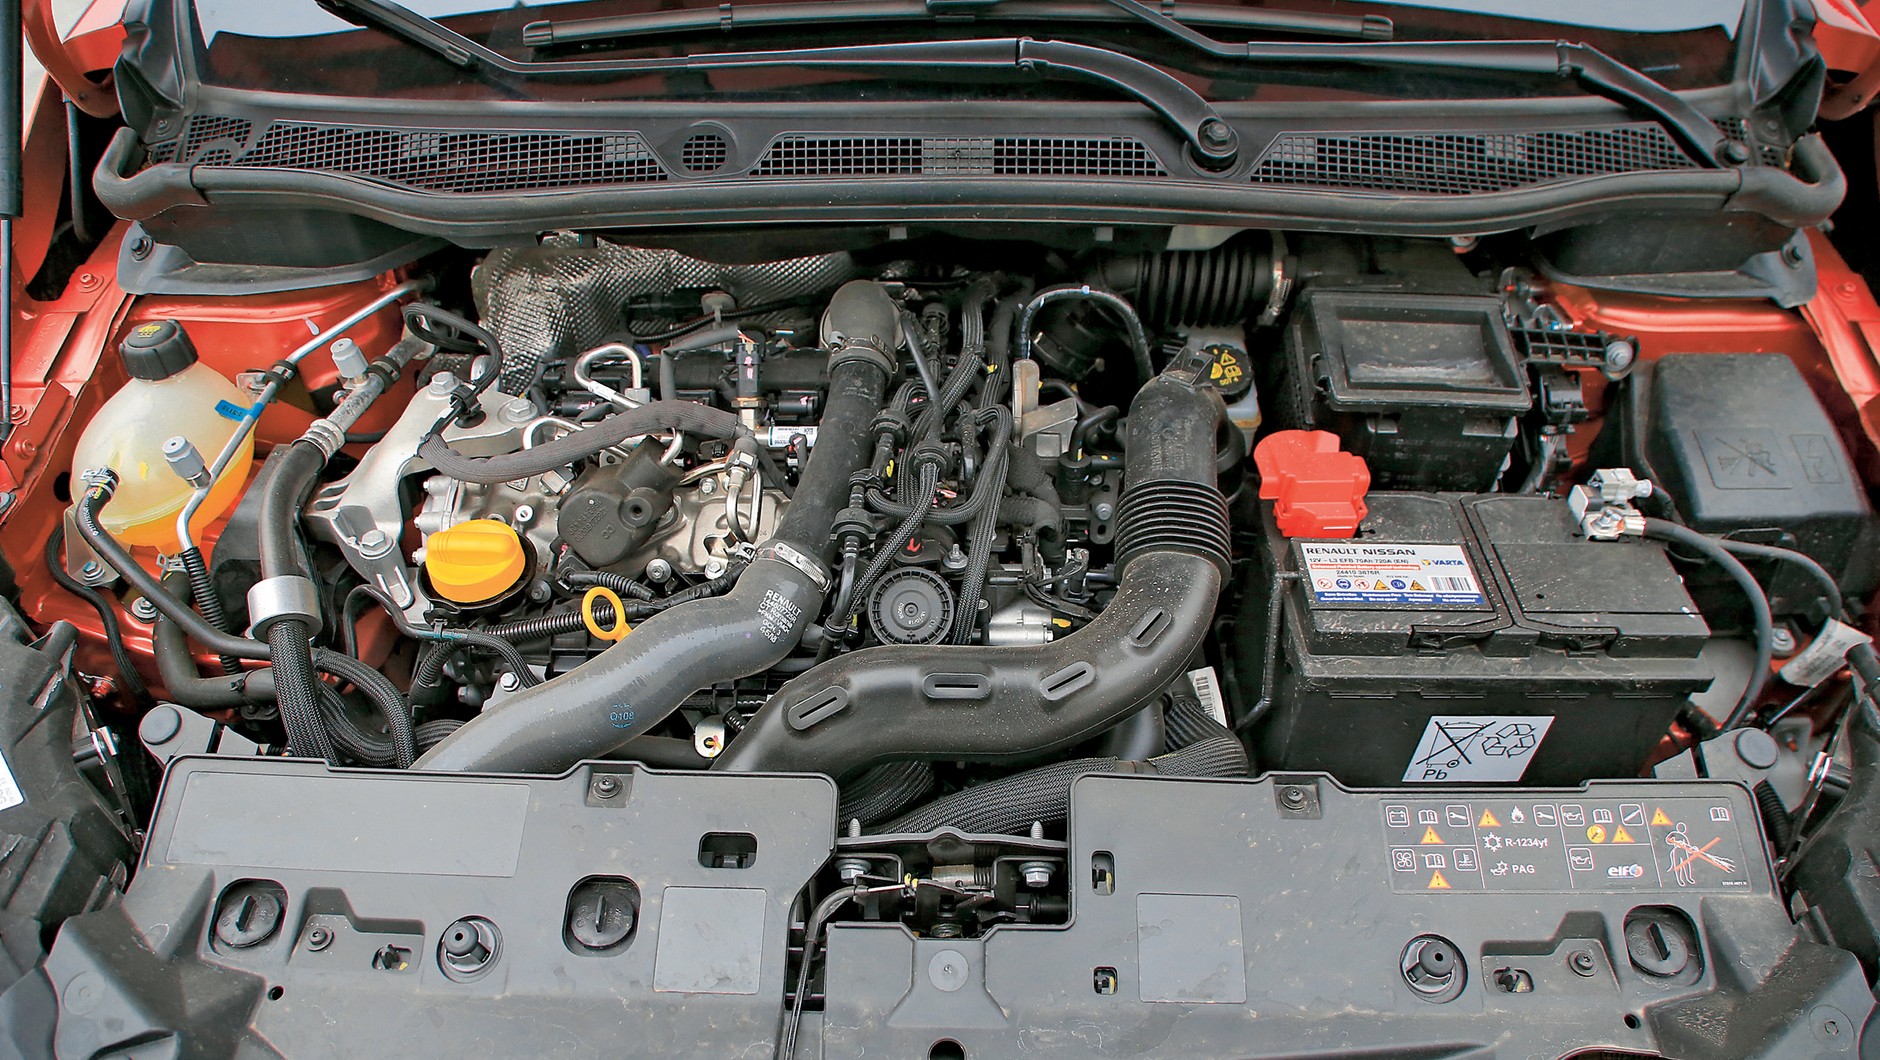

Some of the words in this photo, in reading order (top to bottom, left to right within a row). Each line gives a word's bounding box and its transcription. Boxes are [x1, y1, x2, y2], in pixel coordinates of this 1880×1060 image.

[765, 589, 802, 617] RENAULT
[1422, 769, 1448, 780] Pb
[1504, 837, 1548, 849] R-1234yf
[1511, 864, 1535, 874] PAG
